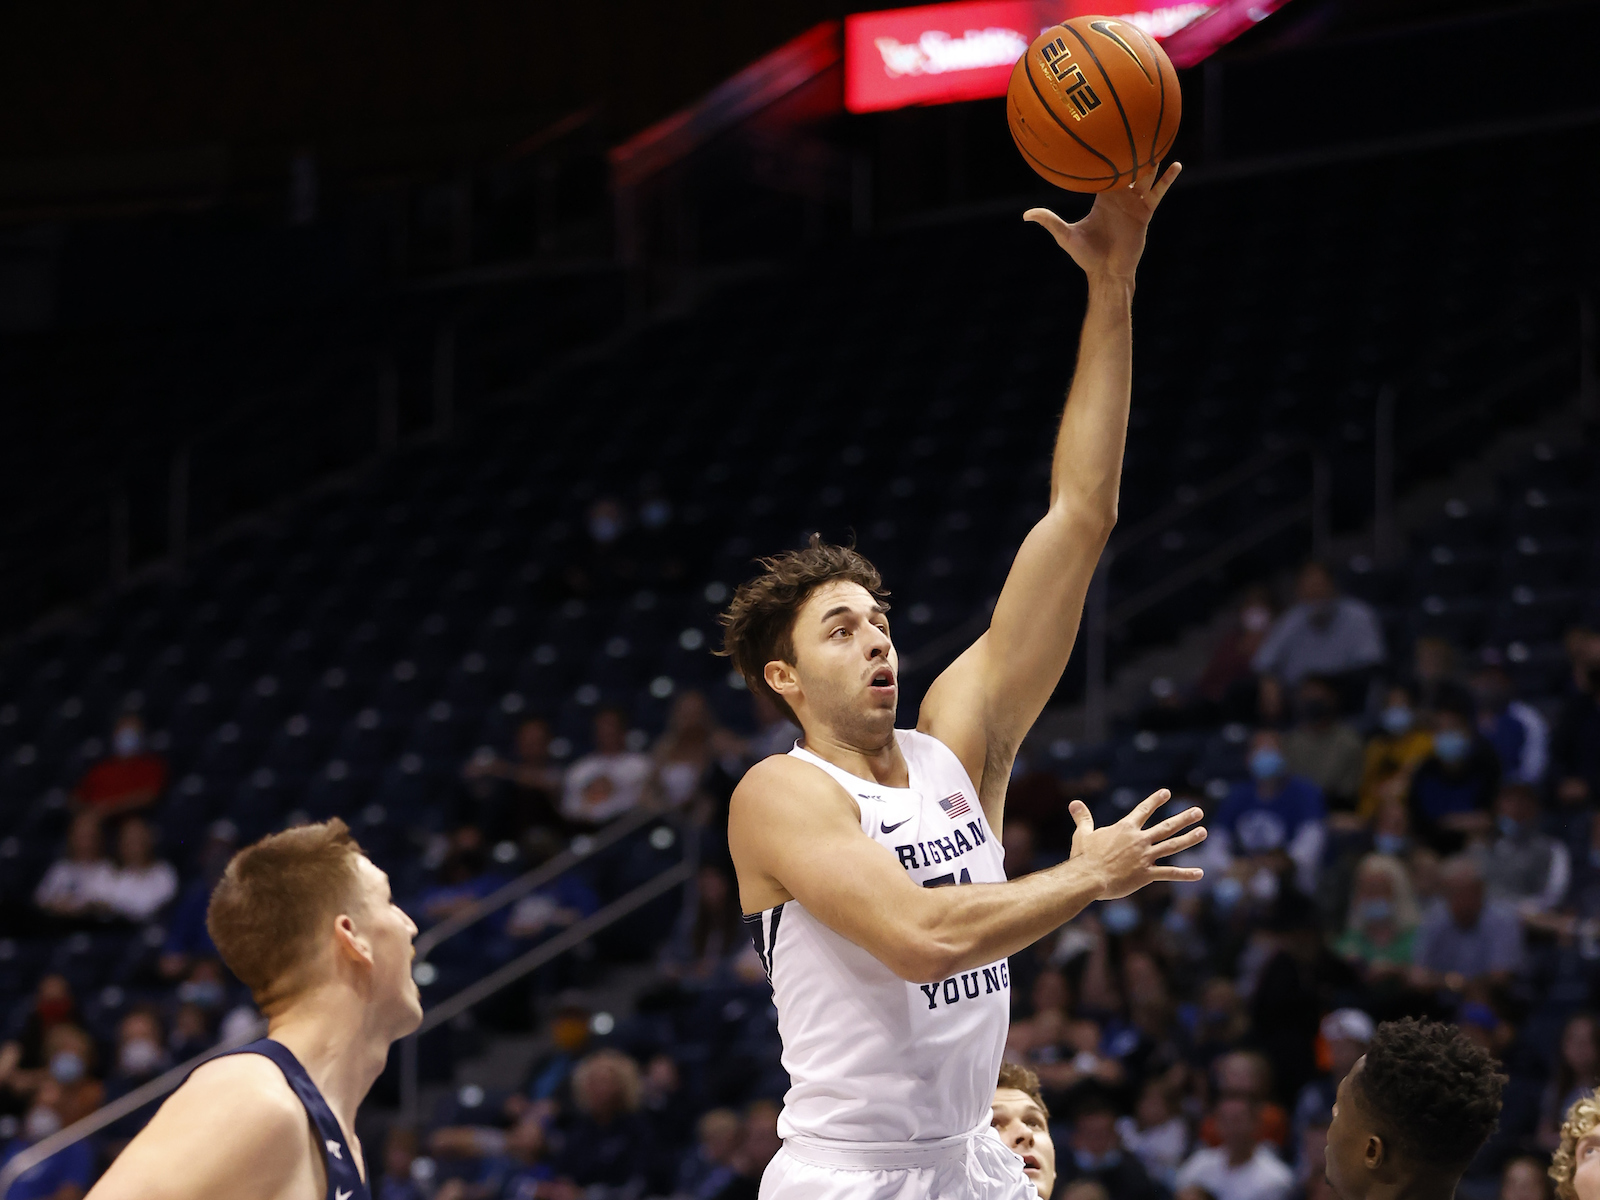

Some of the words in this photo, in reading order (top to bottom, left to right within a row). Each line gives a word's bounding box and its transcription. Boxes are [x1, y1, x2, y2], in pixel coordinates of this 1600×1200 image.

[1035, 51, 1081, 121] HAMPIOHIP
[1040, 36, 1102, 118] ELITE
[920, 962, 1009, 1010] YOUNG
